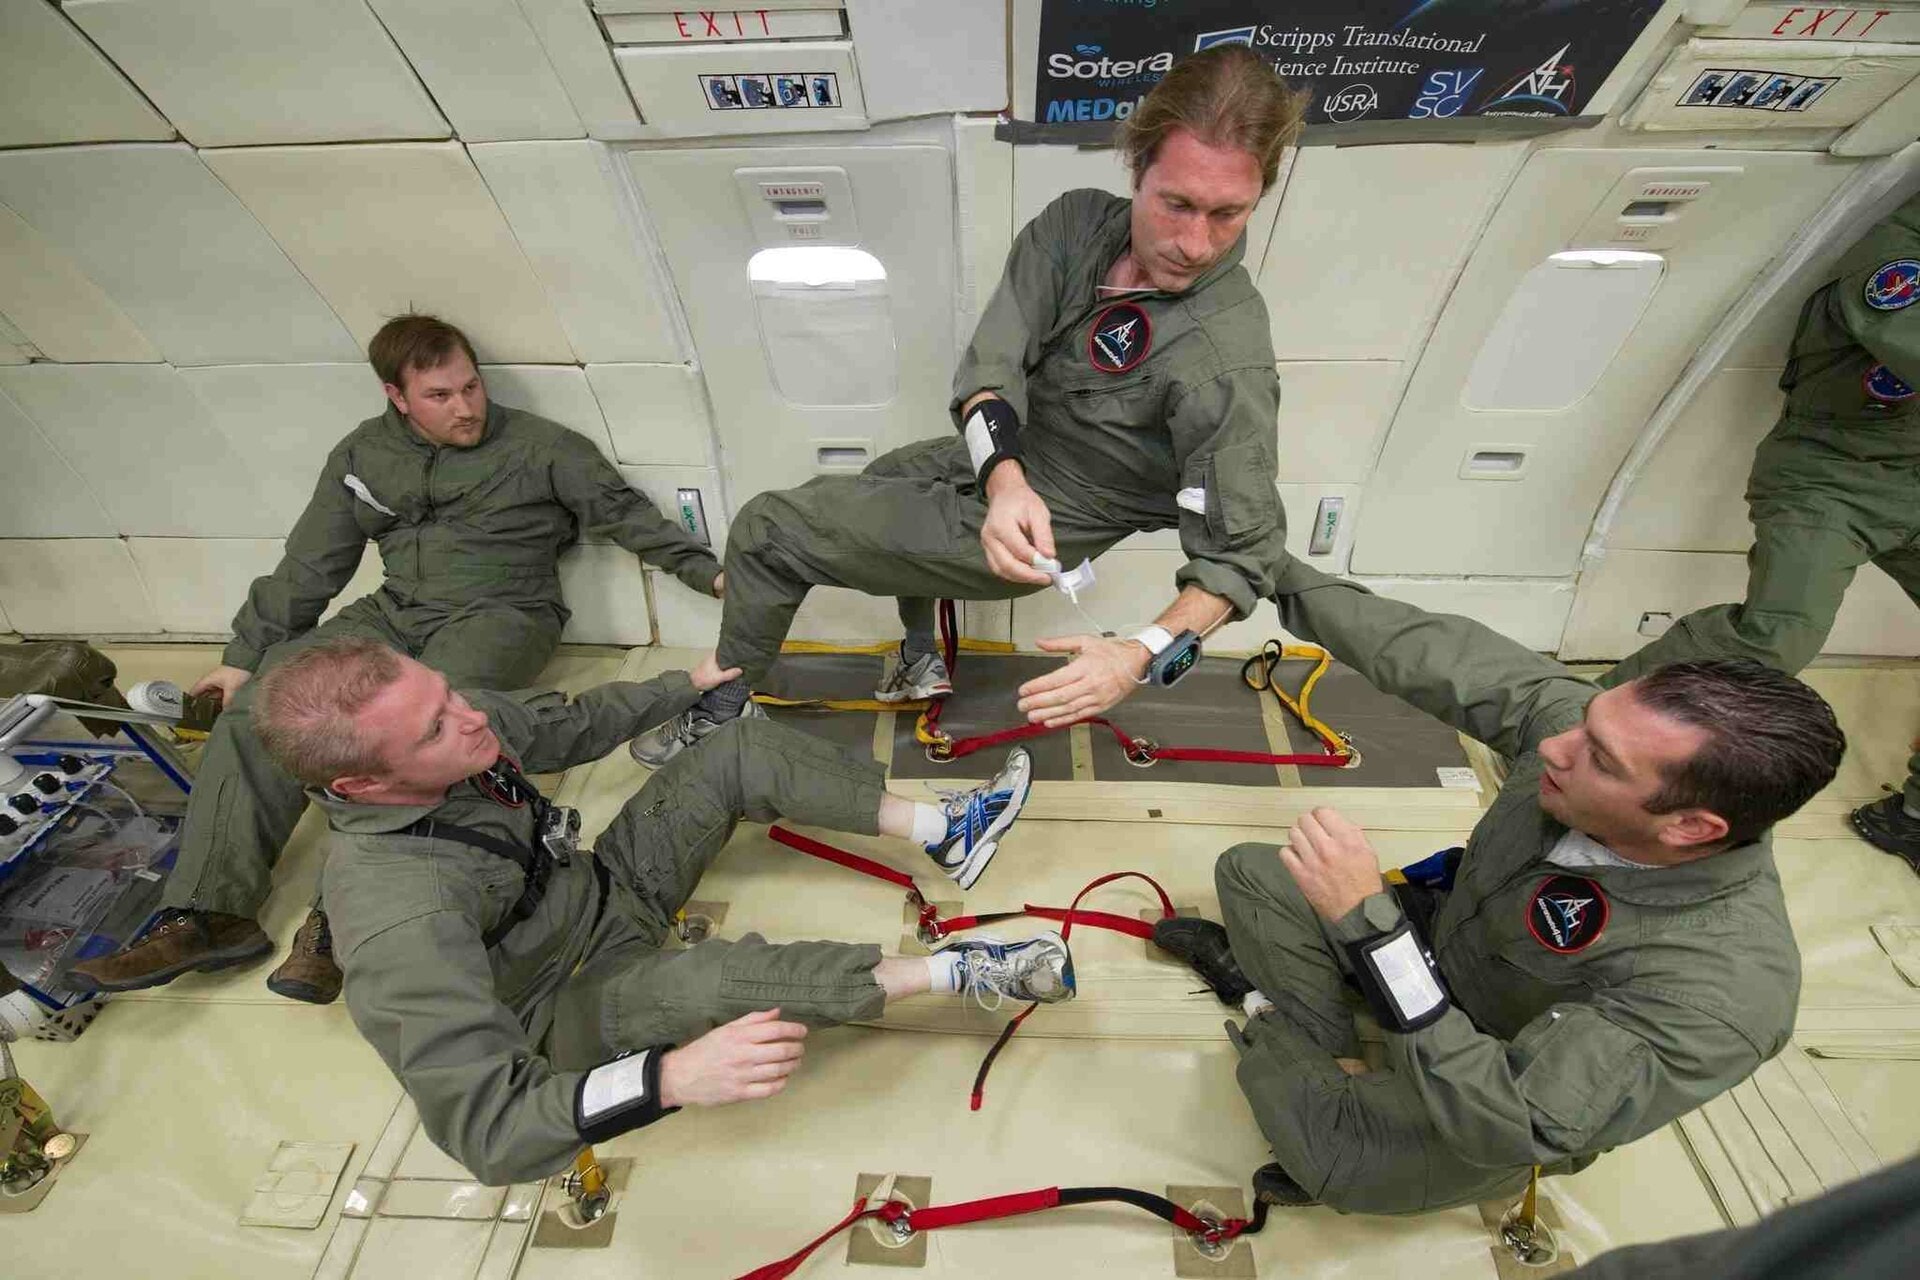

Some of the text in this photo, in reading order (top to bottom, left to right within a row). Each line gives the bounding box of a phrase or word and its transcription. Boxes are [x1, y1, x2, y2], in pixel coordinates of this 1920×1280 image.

[674, 10, 772, 37] EXIT
[1772, 8, 1890, 36] EXIT
[1256, 25, 1487, 54] Scripps Translational
[1047, 52, 1174, 79] Sotera
[1274, 55, 1420, 76] ience Institute
[1422, 68, 1485, 96] SV
[1323, 91, 1379, 113] USRA
[1409, 95, 1463, 119] SC
[682, 505, 696, 533] EXIT
[1324, 511, 1337, 540] EXIT
